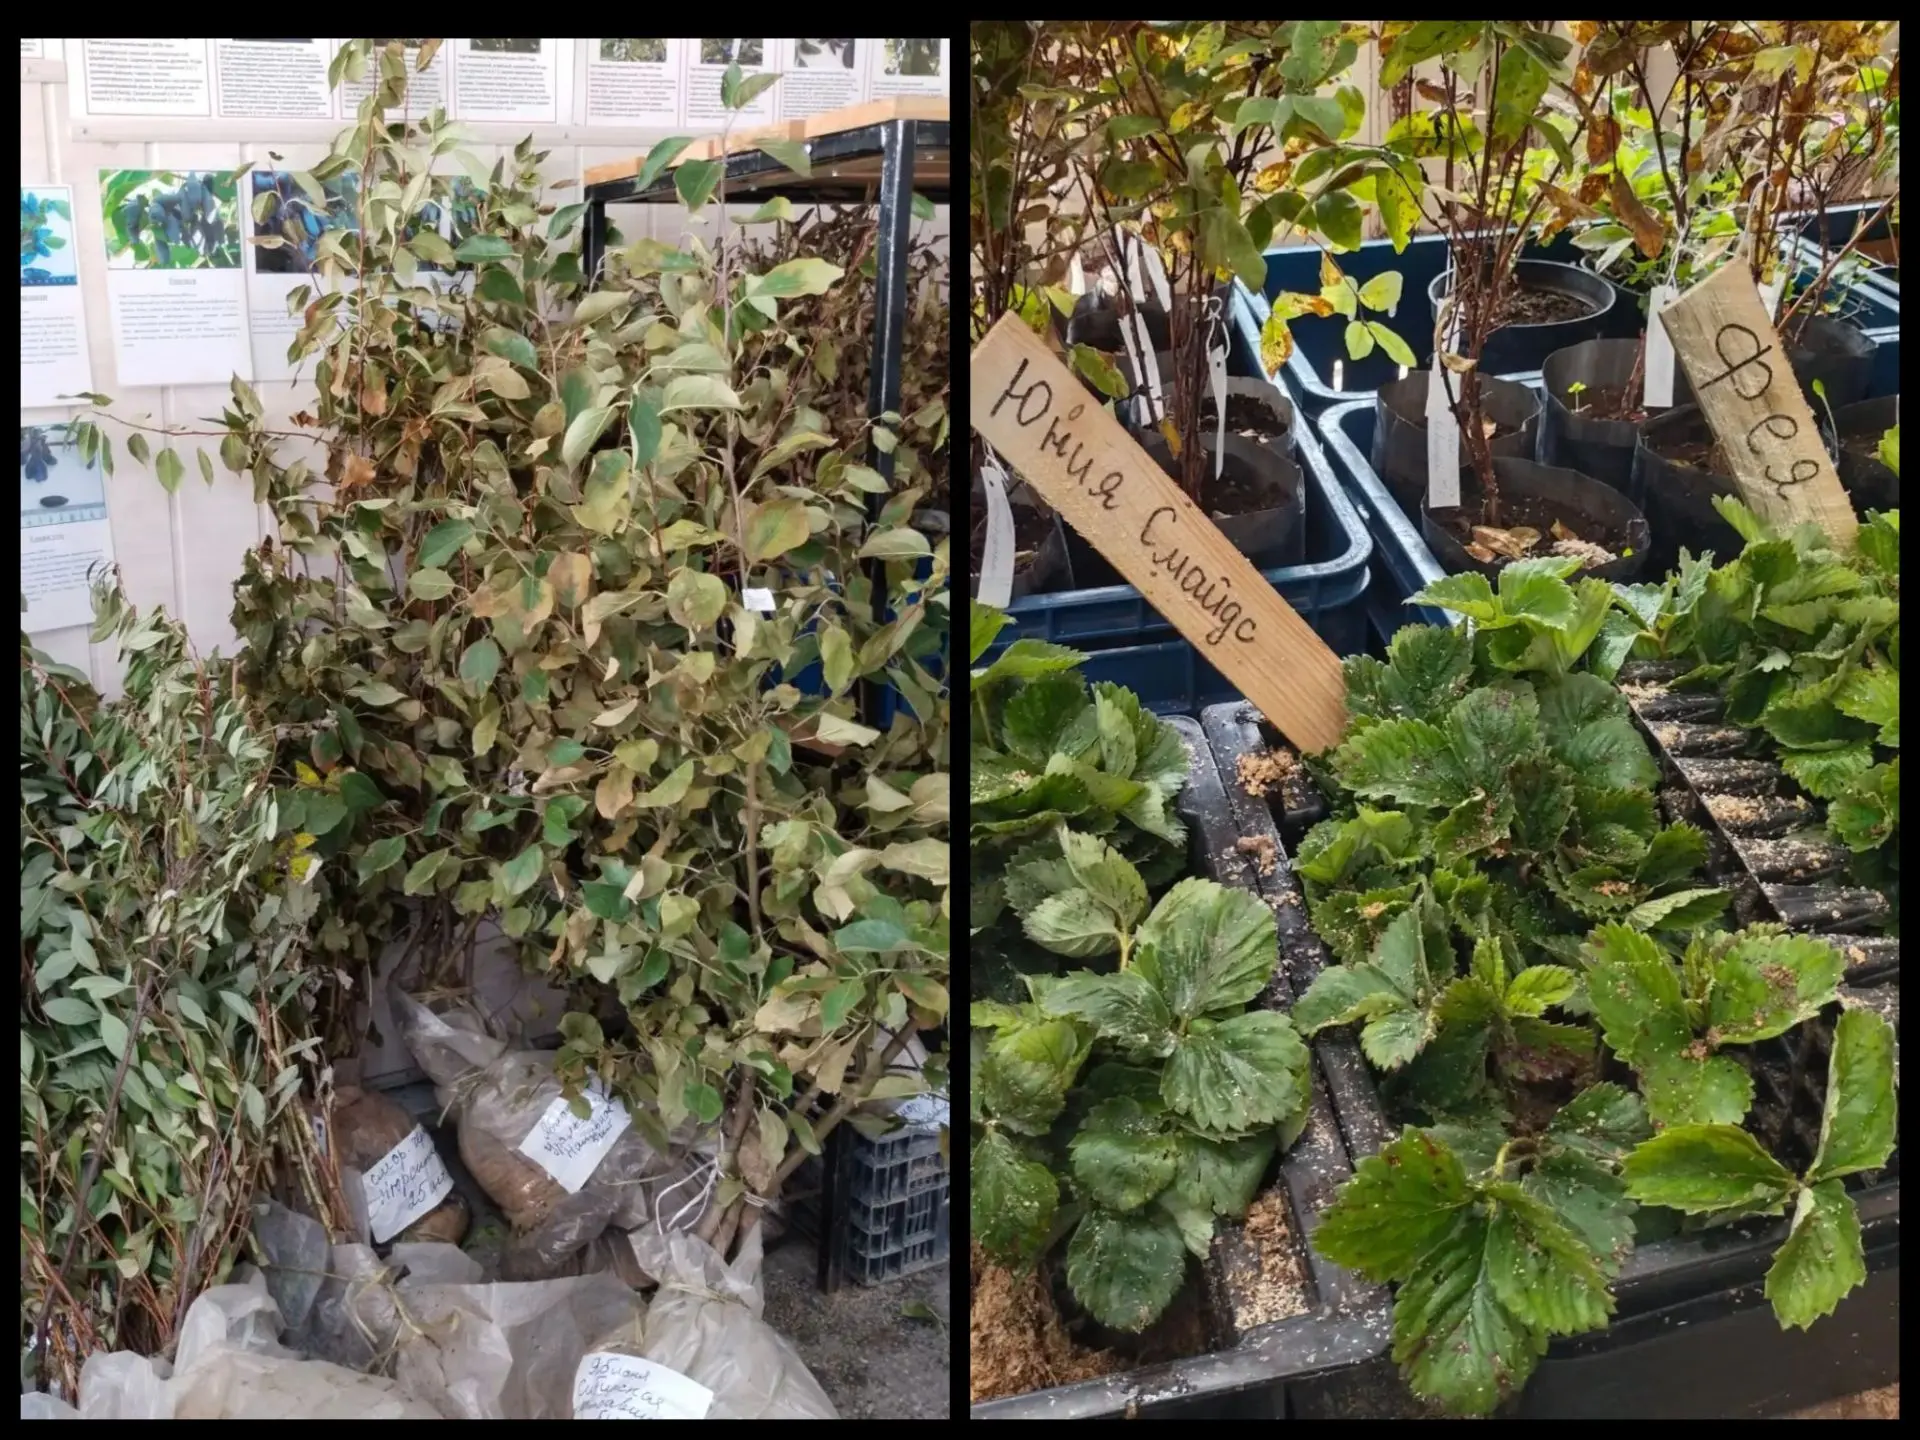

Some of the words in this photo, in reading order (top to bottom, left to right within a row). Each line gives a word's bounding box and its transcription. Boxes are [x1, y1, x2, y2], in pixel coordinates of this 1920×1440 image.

[989, 357, 1125, 511] Юния
[1138, 505, 1259, 647] Смайдс
[1698, 322, 1821, 502] Фея
